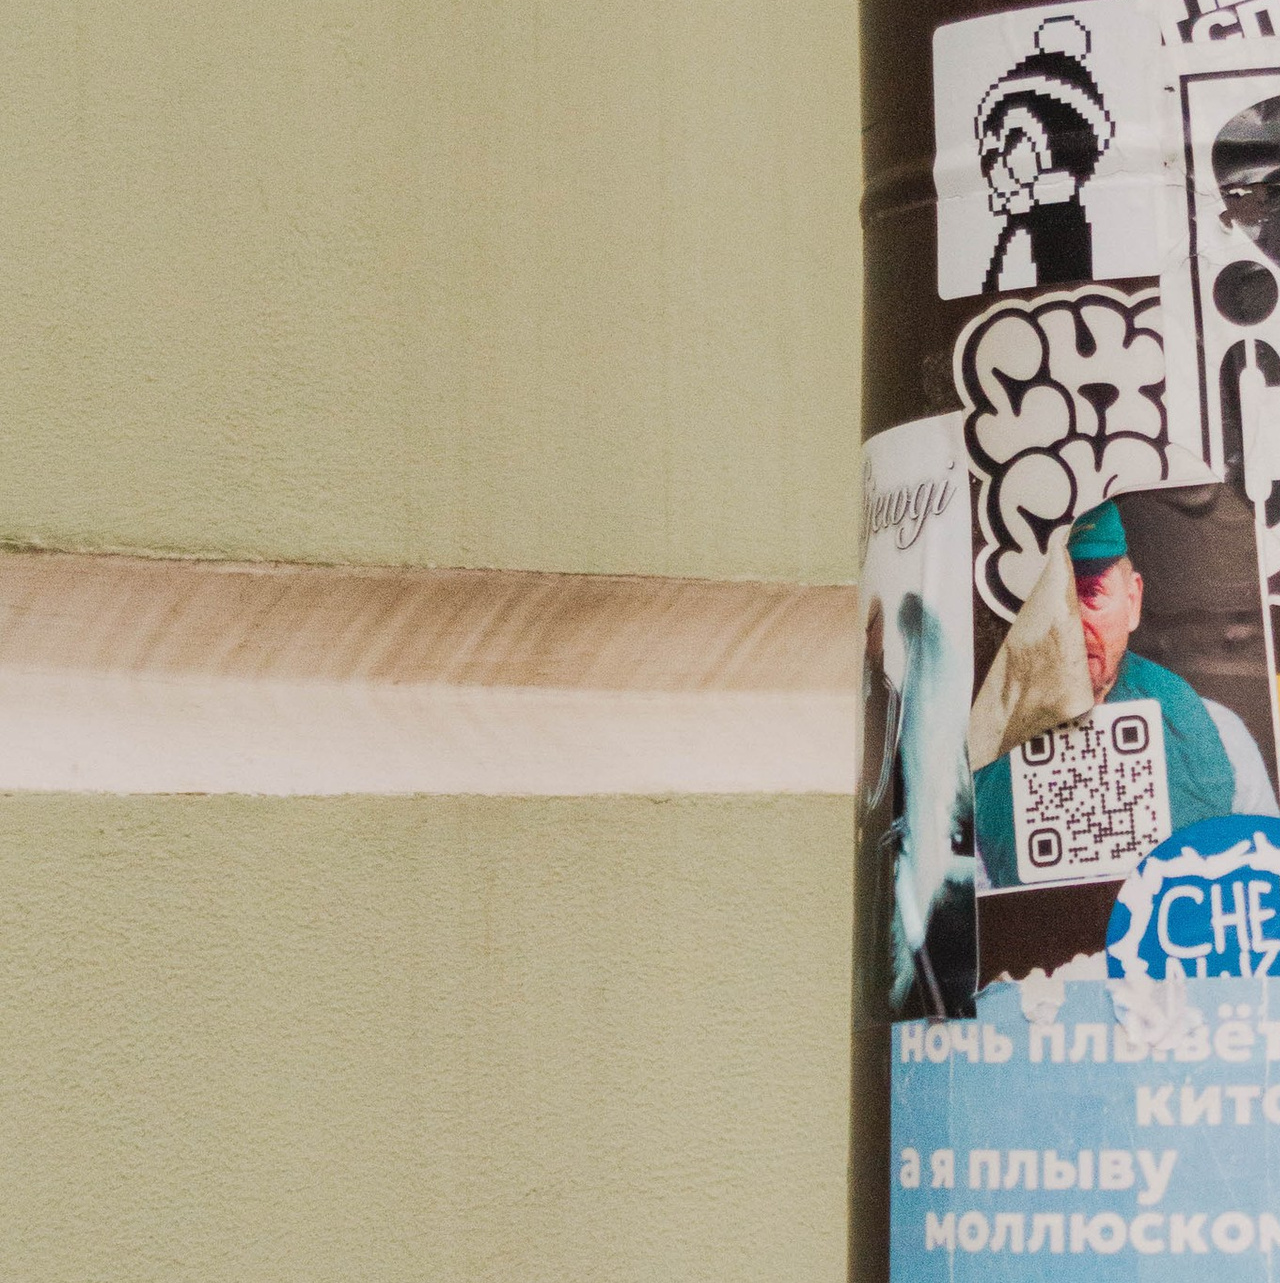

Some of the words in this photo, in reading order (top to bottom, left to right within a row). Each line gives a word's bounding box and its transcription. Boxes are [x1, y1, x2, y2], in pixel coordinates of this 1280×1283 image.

[900, 1023, 1014, 1064] ночь
[900, 1147, 921, 1190] а
[931, 1149, 955, 1190] я
[968, 1149, 1179, 1205] плыву
